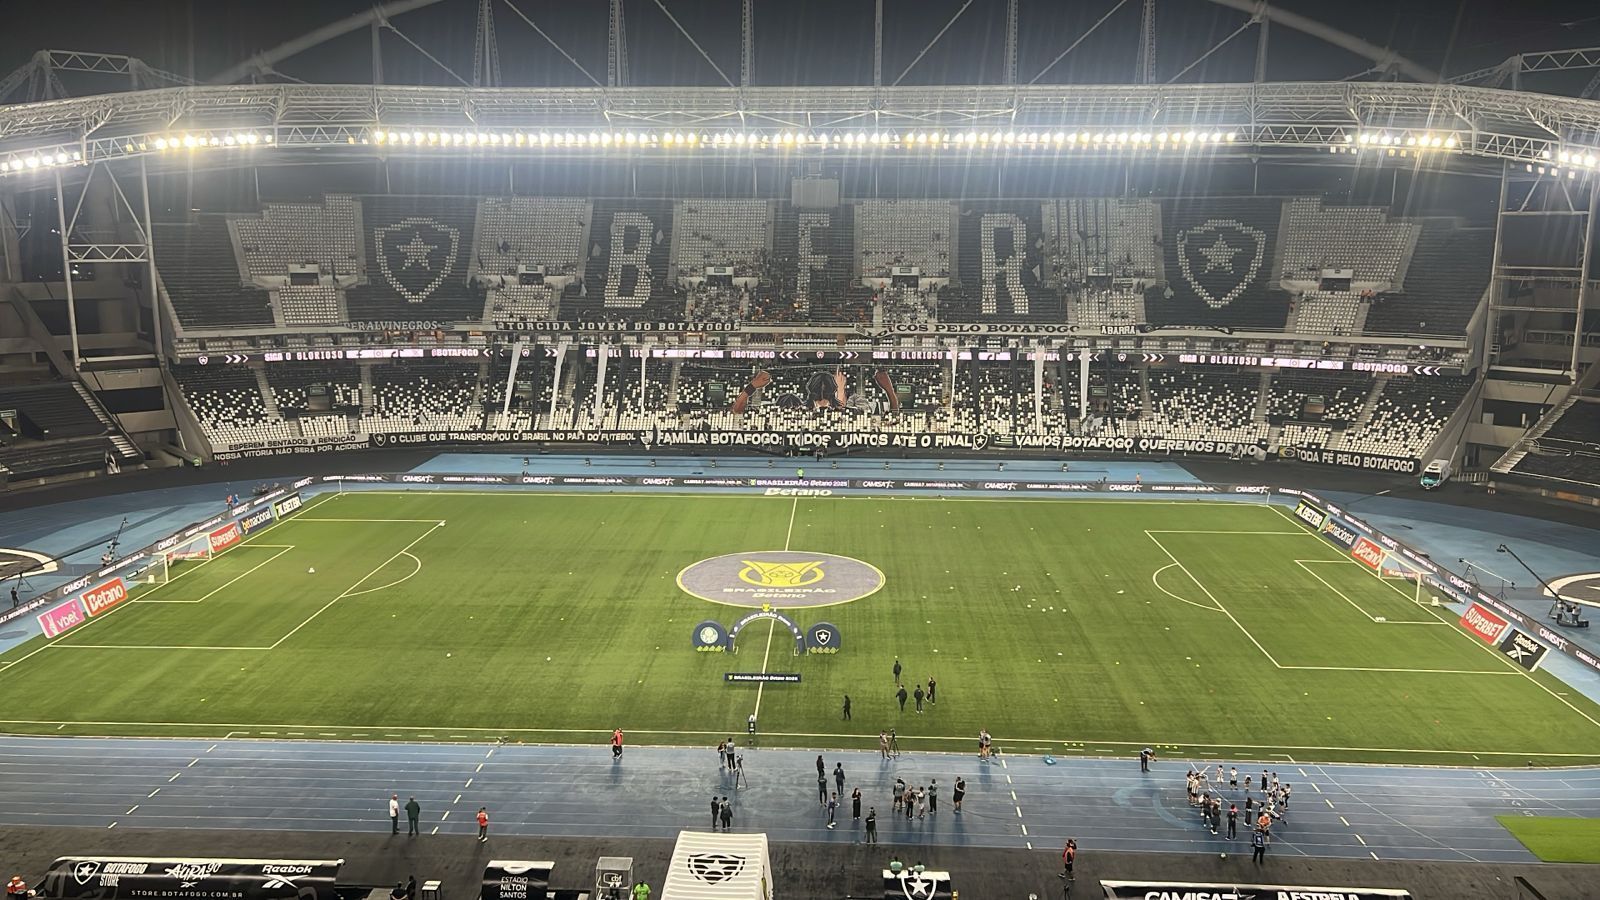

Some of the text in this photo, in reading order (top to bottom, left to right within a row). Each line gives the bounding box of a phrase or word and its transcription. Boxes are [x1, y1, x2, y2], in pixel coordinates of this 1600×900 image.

[506, 322, 571, 330] TORCIDA
[578, 322, 626, 330] JOVEM
[659, 322, 732, 330] BOTAFOGO
[934, 324, 980, 332] PELO
[228, 442, 264, 450] ESPEREM
[268, 438, 308, 447] SENTADOS
[400, 434, 426, 443] CLUBE
[429, 433, 446, 441] QUE
[587, 433, 598, 441] DO
[787, 434, 831, 446] TODOS
[835, 434, 888, 447] JUNTOS
[892, 433, 916, 447] ATÉ
[921, 434, 931, 446] O
[935, 434, 972, 447] FINAL
[1015, 436, 1061, 446] VAMOS
[1062, 436, 1134, 449] BOTAFOGO
[1139, 439, 1214, 452] QUEREMOS
[214, 452, 241, 461] NOSSA
[1322, 451, 1334, 463] FÉ
[1337, 455, 1360, 466] PELO
[1363, 456, 1414, 472] BOTAFOGO
[211, 528, 238, 546] SUPERBET
[88, 585, 123, 612] Betano
[57, 611, 80, 628] vbet
[1466, 608, 1502, 638] SUPERBET
[1514, 634, 1538, 653] Reebok
[103, 863, 148, 874] BOTAFOGO
[262, 864, 312, 874] Reebok
[100, 874, 119, 887] STORE
[501, 876, 528, 884] ESTÁDIO
[132, 890, 243, 898] STORE.BOTAFOGO.COM.BR
